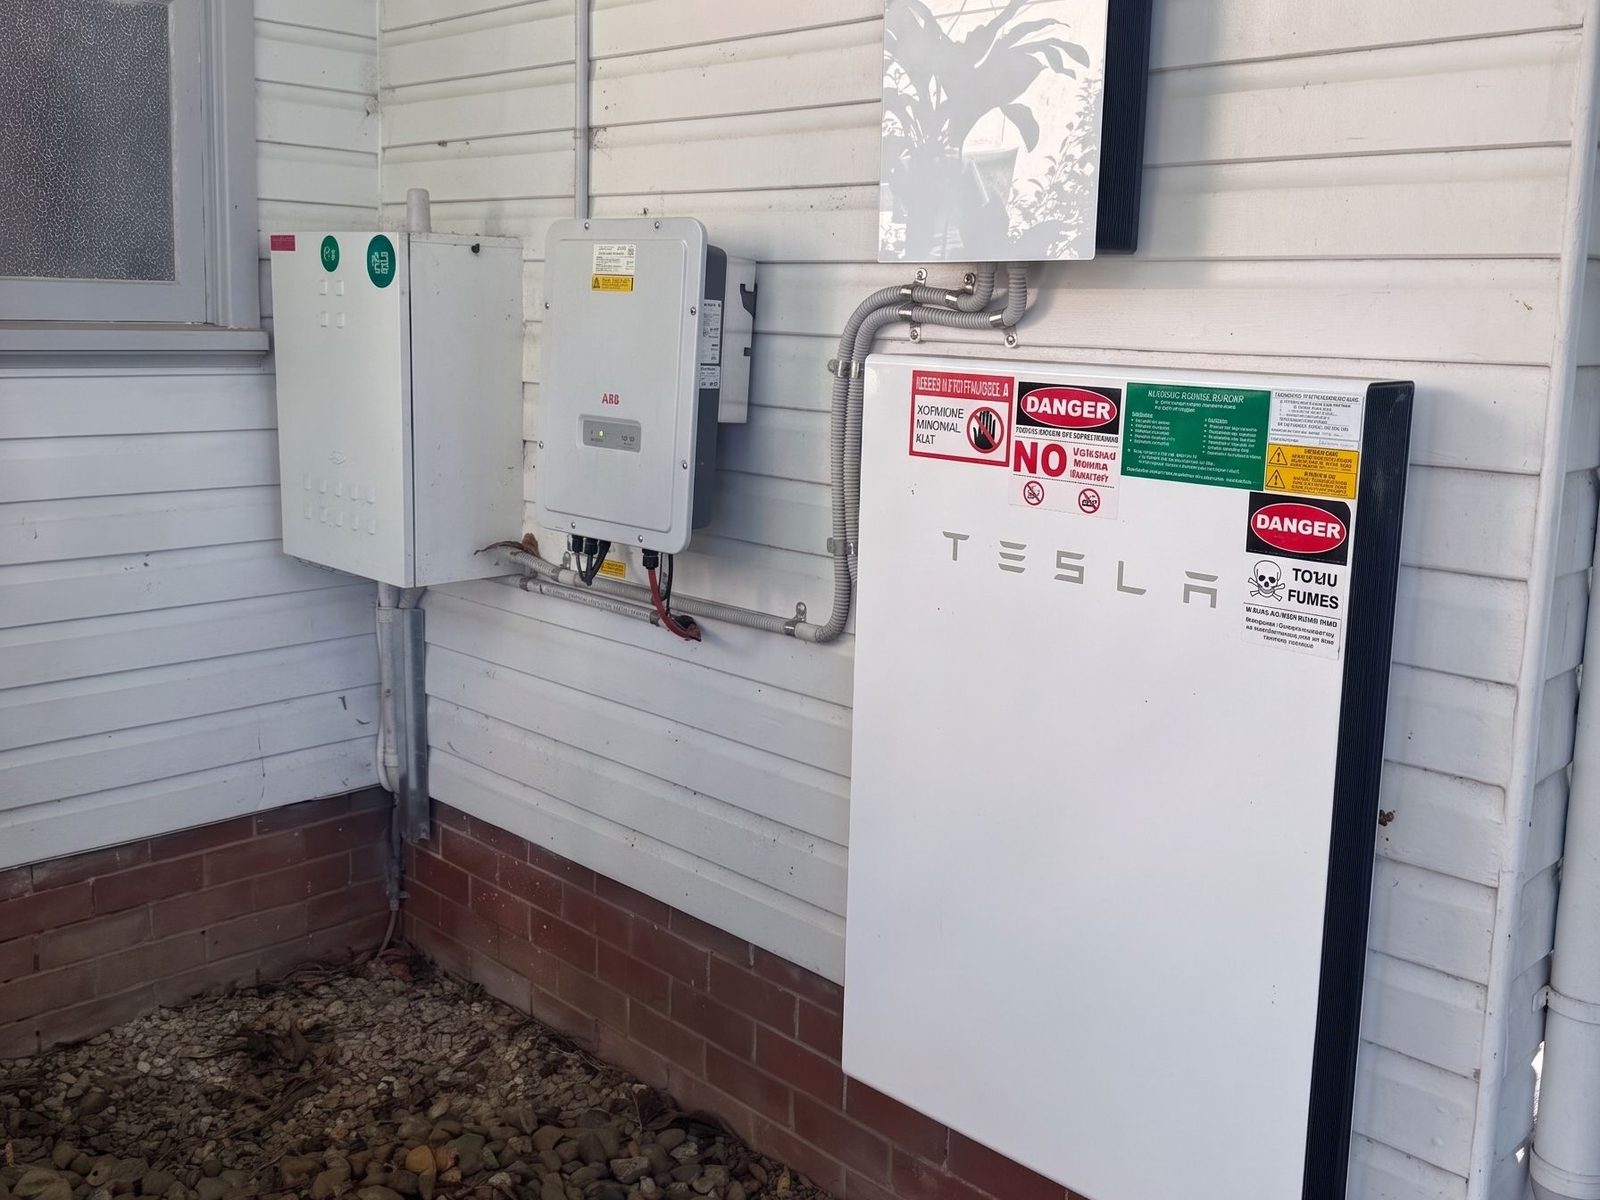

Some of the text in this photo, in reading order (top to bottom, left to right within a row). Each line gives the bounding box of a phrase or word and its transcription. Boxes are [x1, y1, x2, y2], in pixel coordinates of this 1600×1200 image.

[1026, 396, 1111, 420] DANGER
[1013, 440, 1067, 478] NO
[1256, 513, 1341, 540] DANGER
[942, 530, 1219, 609] TESLA
[1287, 588, 1339, 610] FUMES
